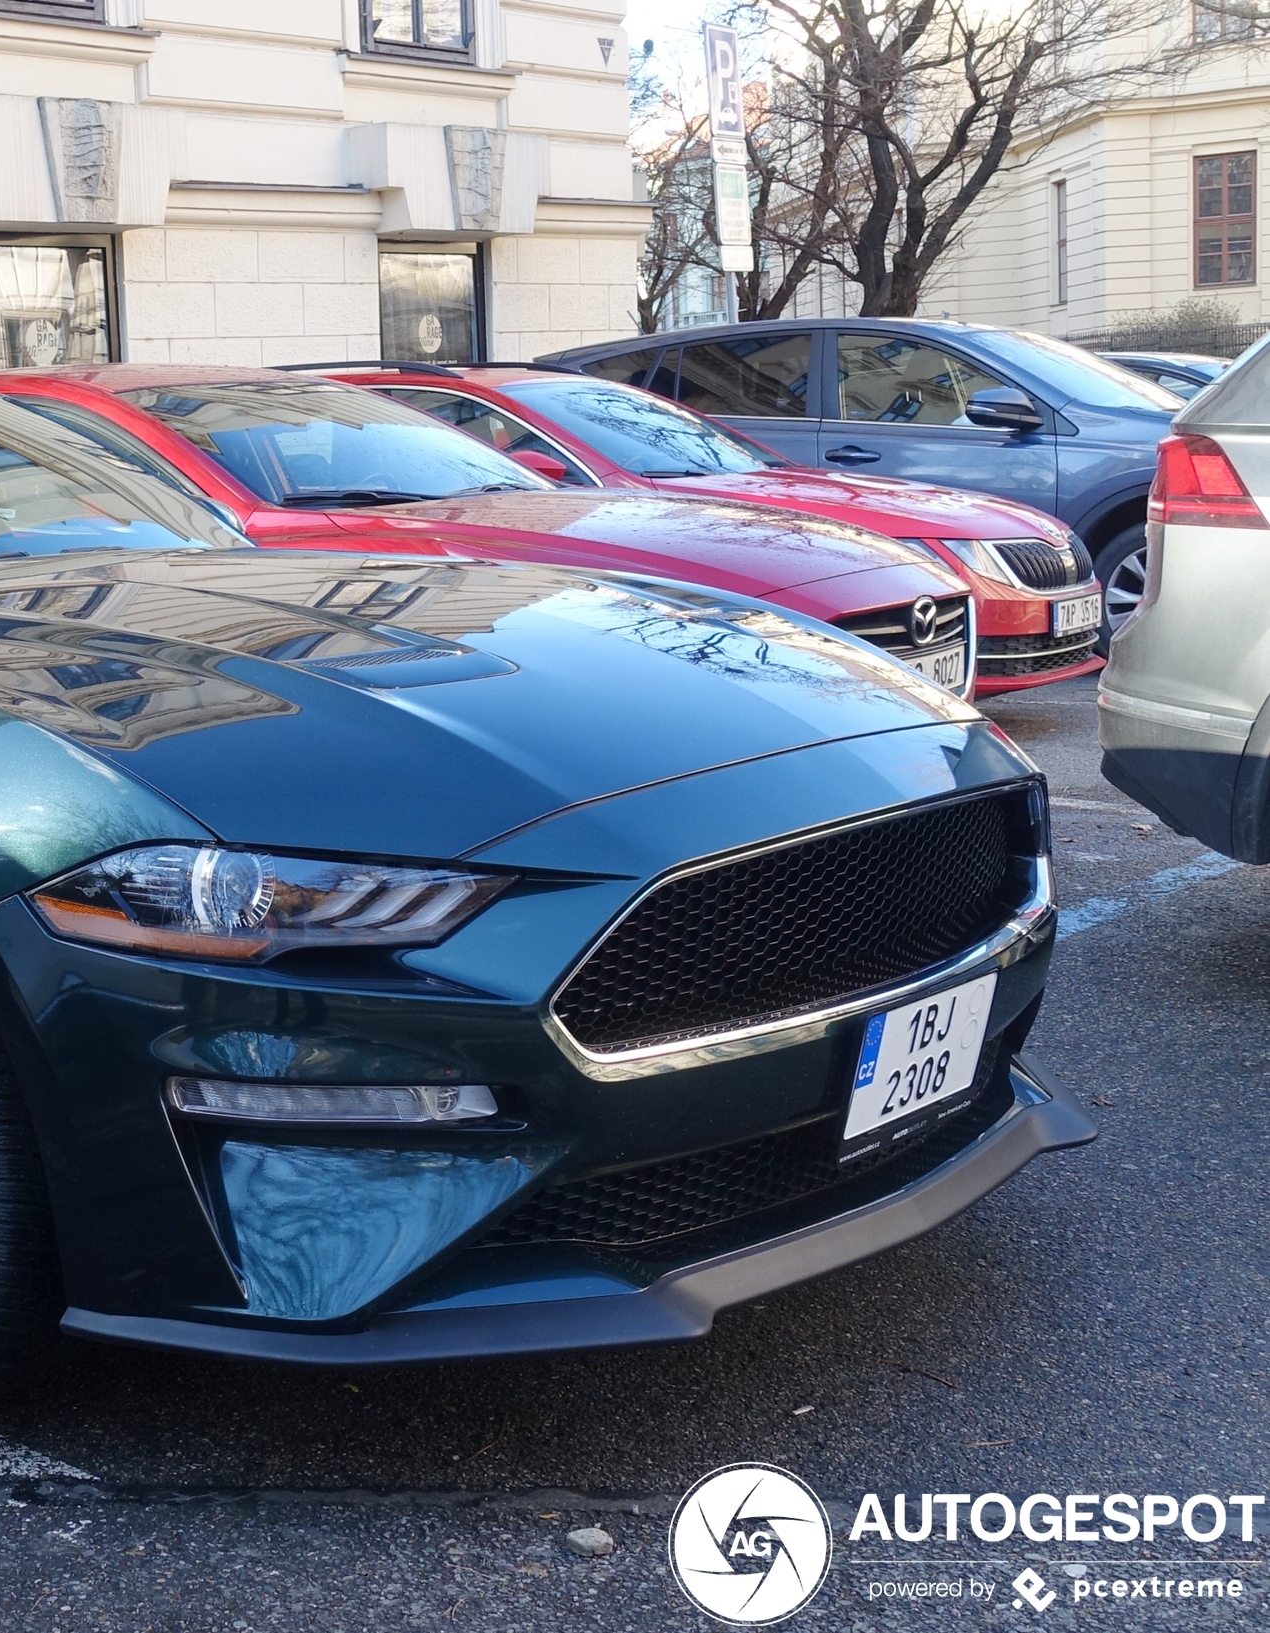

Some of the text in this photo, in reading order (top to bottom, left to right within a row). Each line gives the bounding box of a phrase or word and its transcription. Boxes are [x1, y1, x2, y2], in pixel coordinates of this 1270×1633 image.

[1060, 597, 1099, 629] 7AP 3516
[933, 651, 960, 685] 8027
[908, 995, 957, 1054] 1BJ
[858, 1060, 875, 1081] CZ
[881, 1050, 950, 1116] 2308
